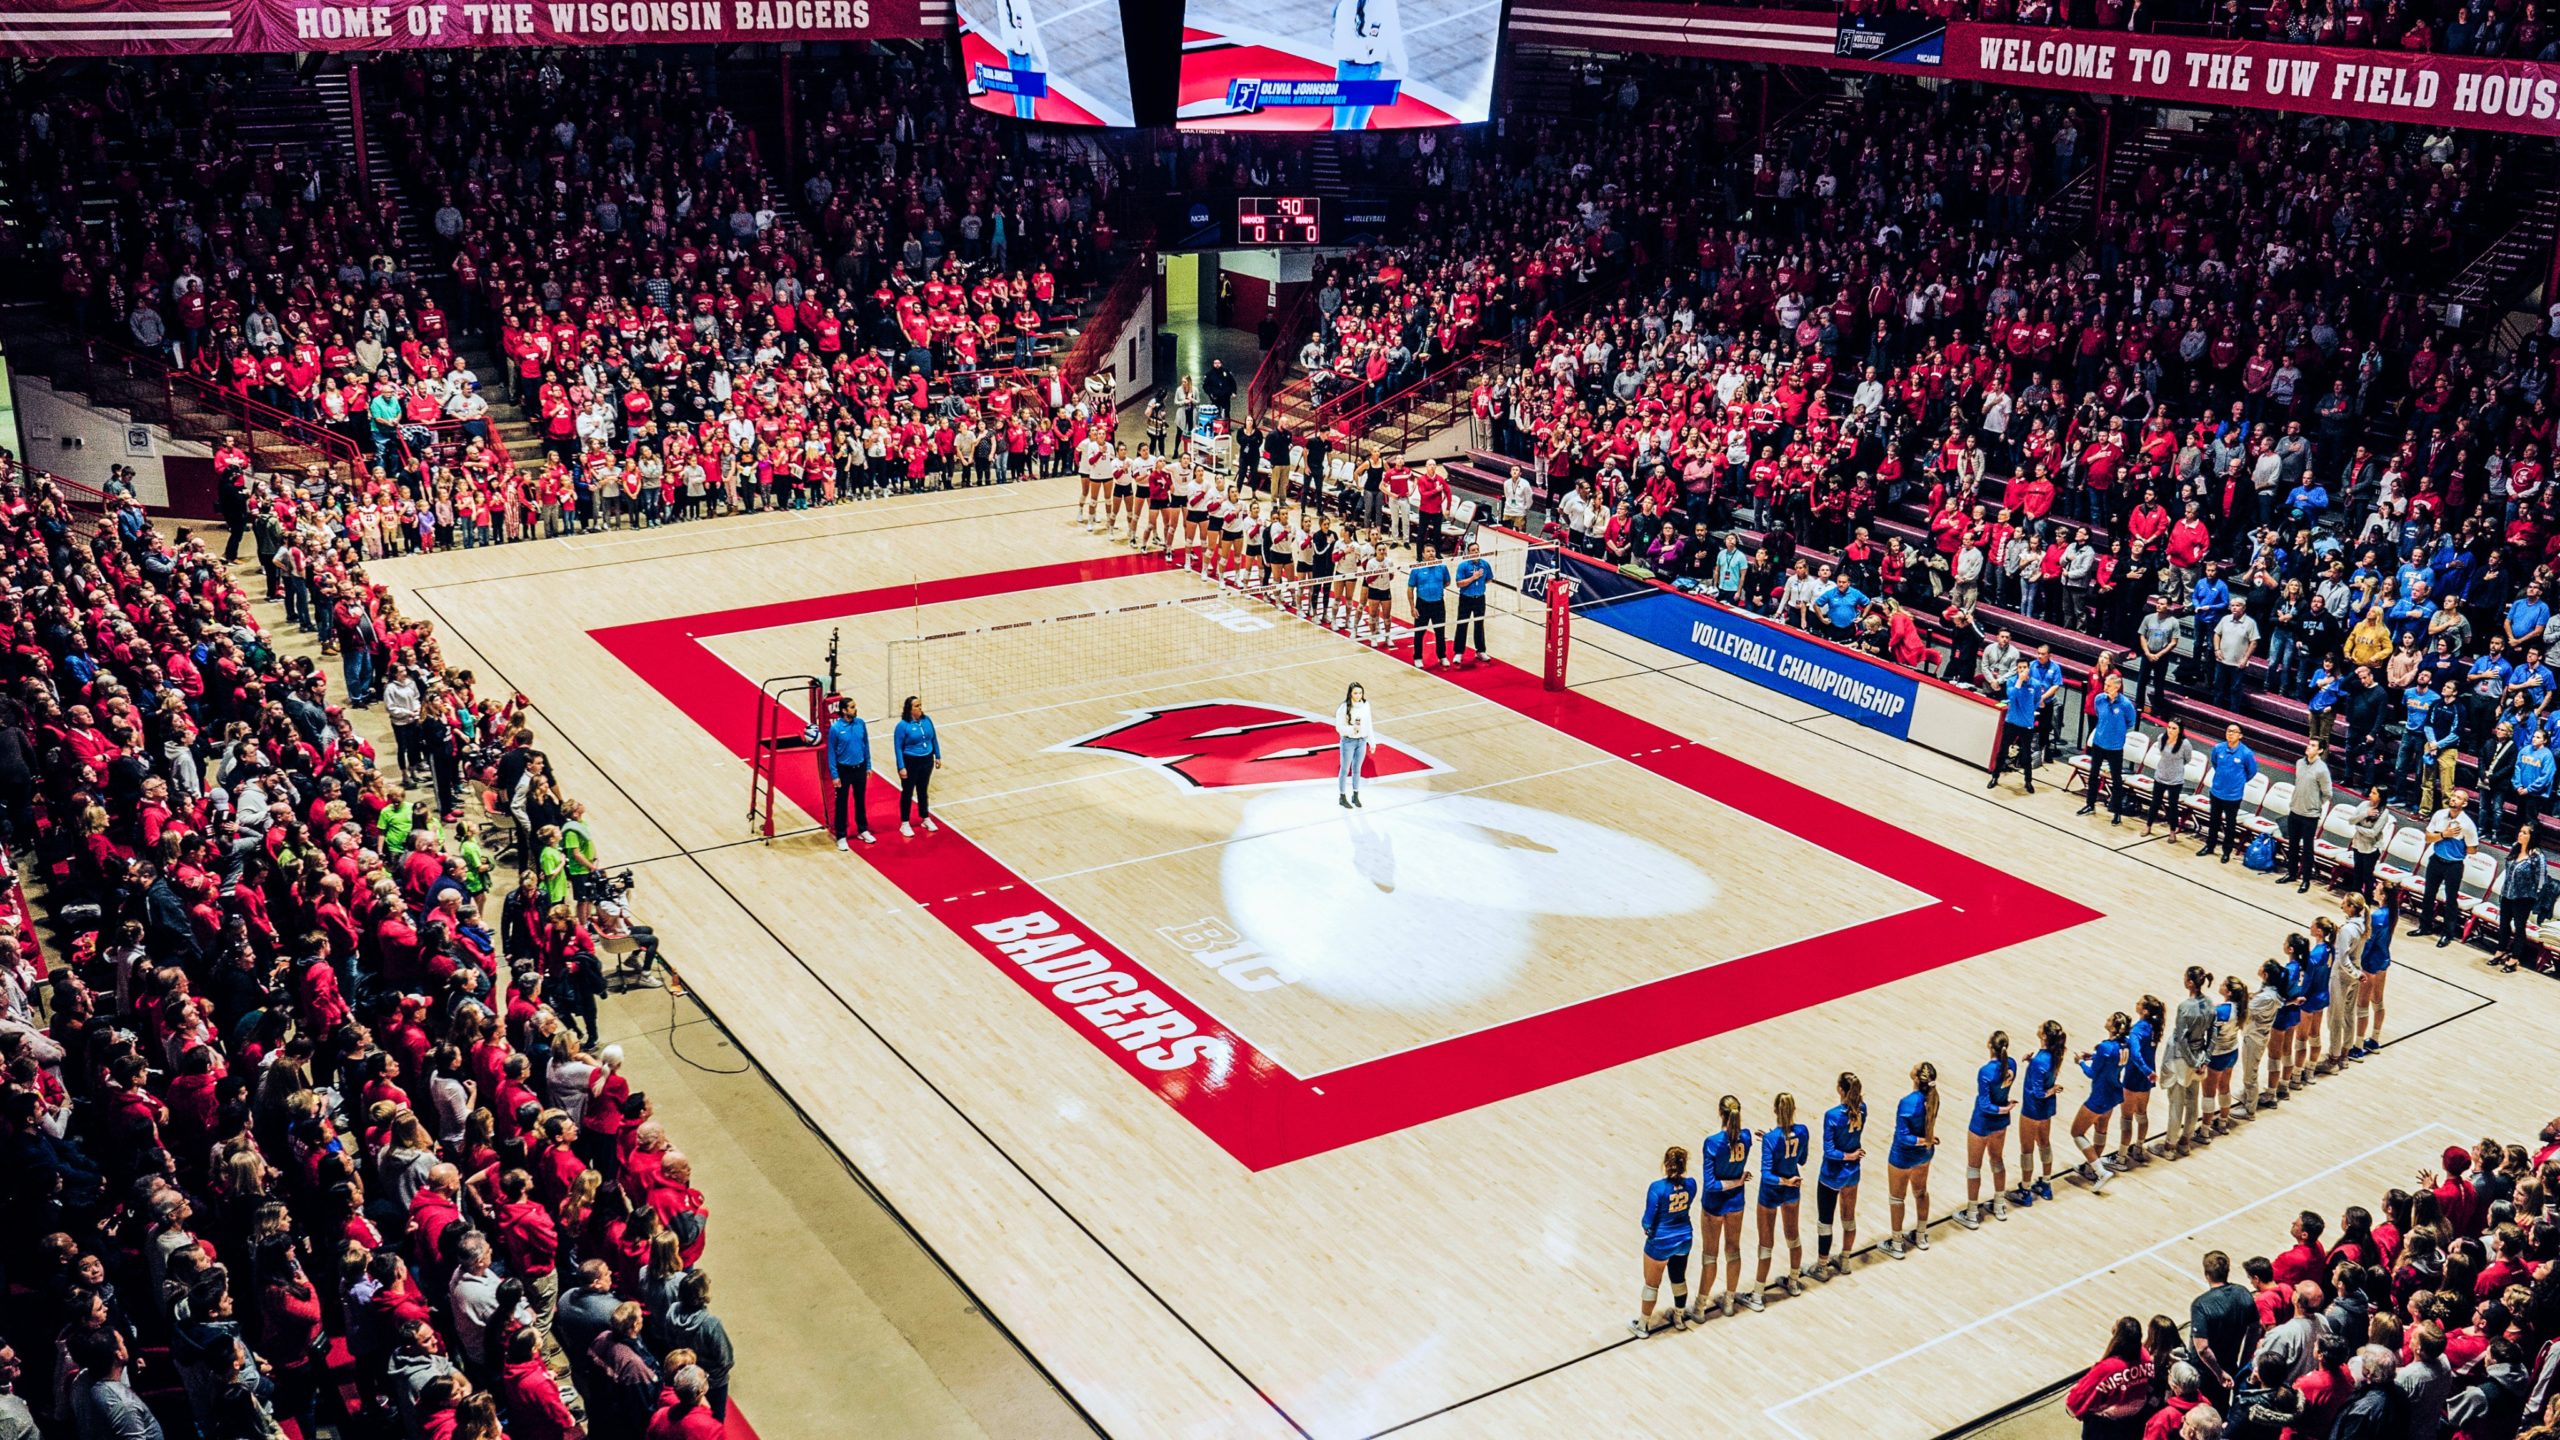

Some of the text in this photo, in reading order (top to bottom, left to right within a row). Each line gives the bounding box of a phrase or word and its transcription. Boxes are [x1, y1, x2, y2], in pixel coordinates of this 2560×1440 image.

[295, 1, 870, 39] HOME OF THE WISCONSIN BADGERS
[1260, 83, 1339, 95] OLIVIA JOHNSON
[1980, 37, 2560, 120] WELCOME TO THE UW FIELD HOUS
[1255, 225, 1265, 242] 0
[1307, 225, 1317, 242] 0
[1556, 606, 1564, 678] BADGERS
[1690, 620, 1905, 718] VOLLEYBALL CHAMPIONSHIP
[971, 910, 1231, 1071] BADGERS
[1729, 1142, 1745, 1163] 18
[1784, 1137, 1800, 1159] 17
[1668, 1190, 1690, 1213] 22
